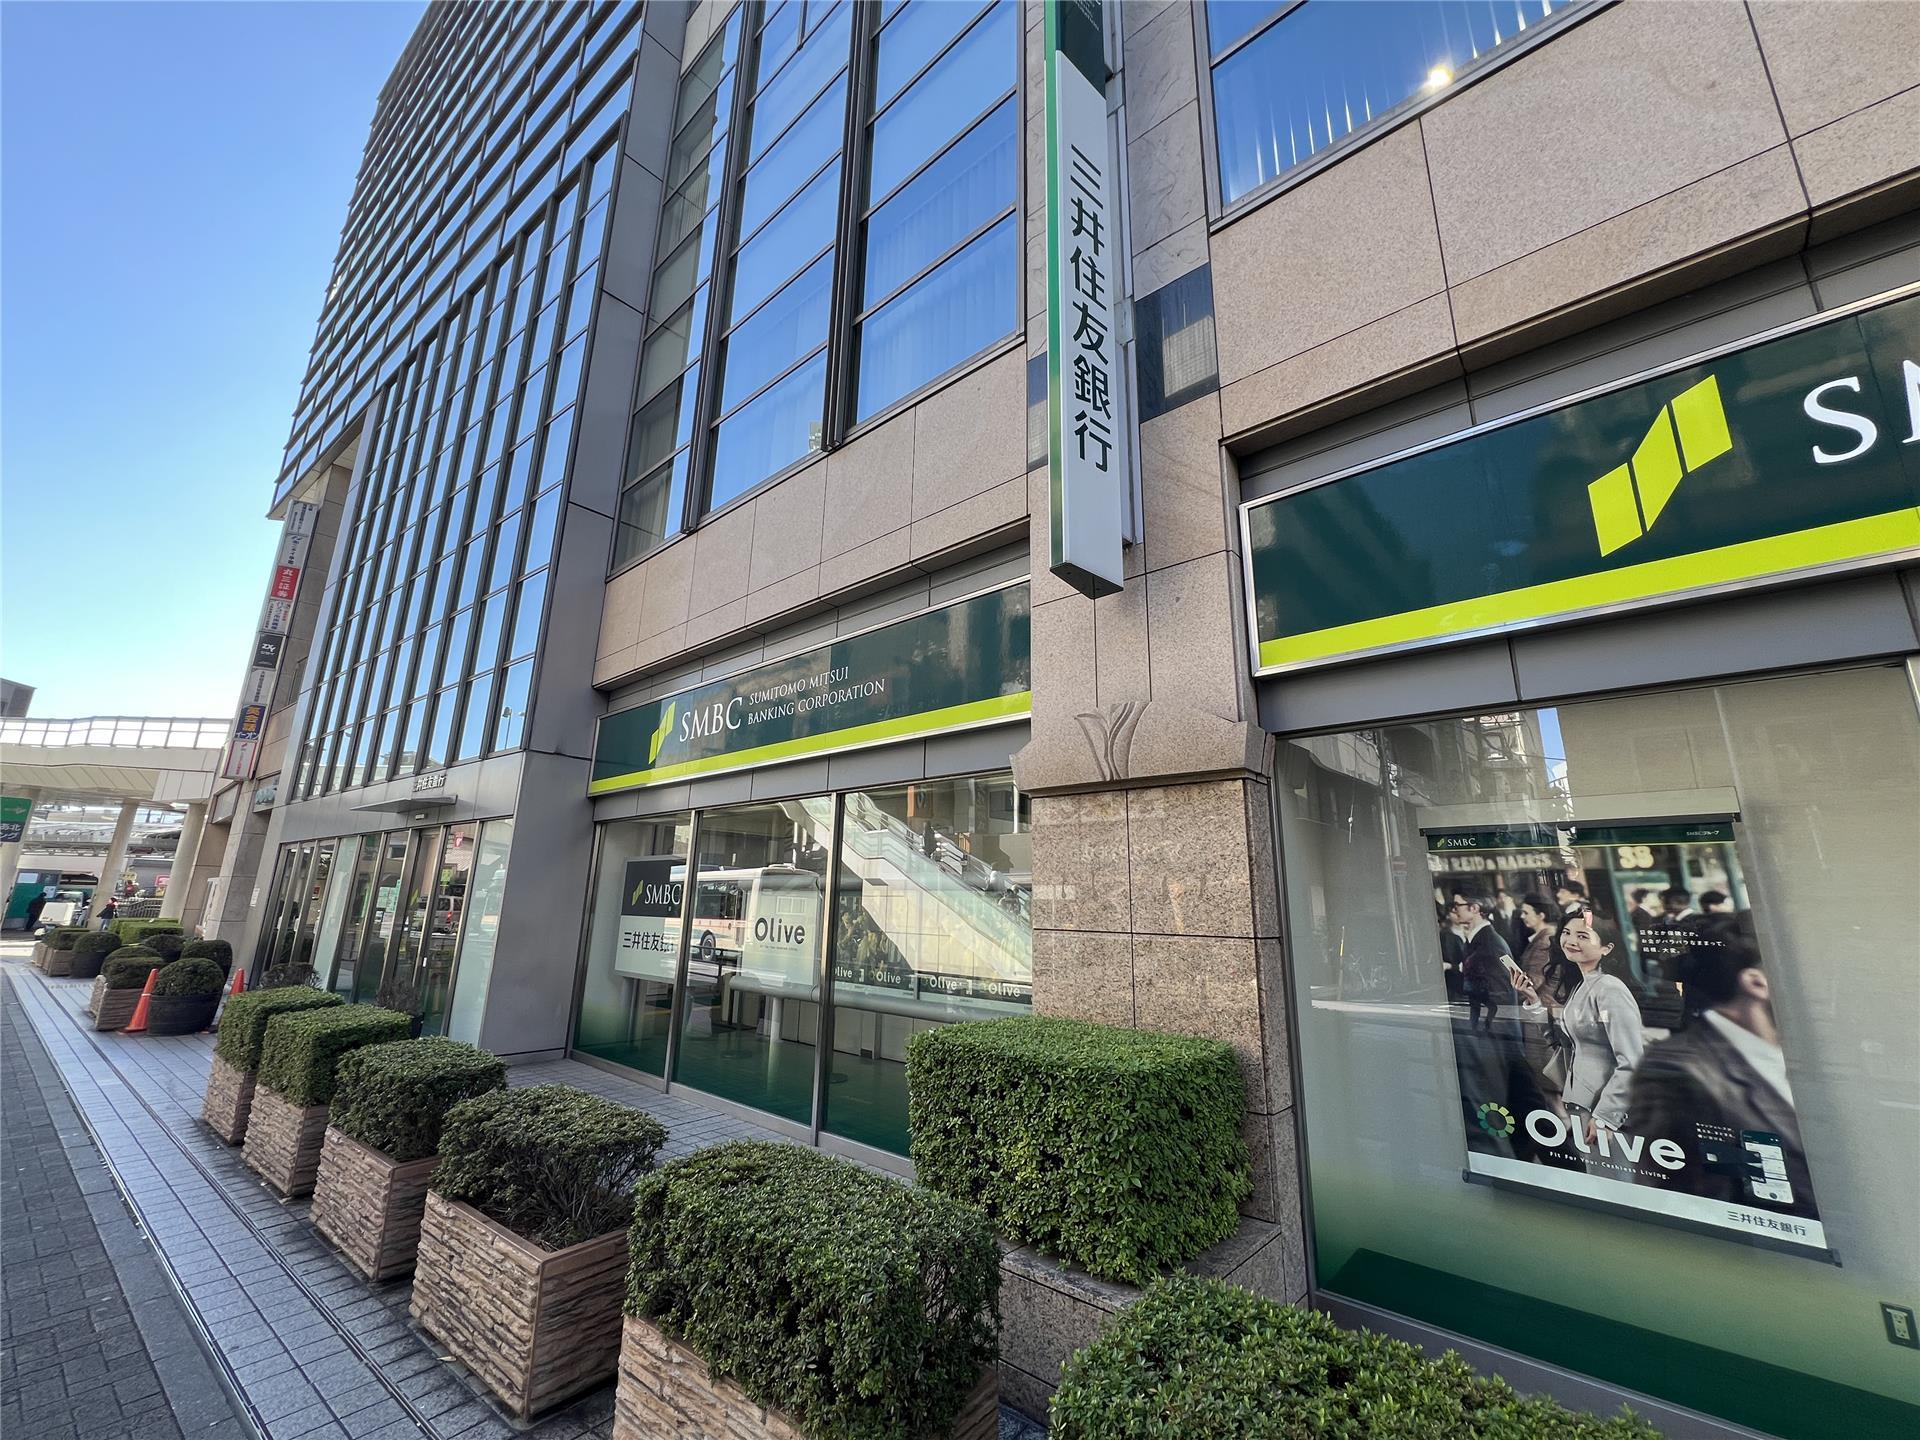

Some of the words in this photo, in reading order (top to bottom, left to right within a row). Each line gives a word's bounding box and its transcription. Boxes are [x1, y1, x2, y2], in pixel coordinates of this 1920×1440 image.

[1070, 143, 1112, 472] 三井住友銀行
[1803, 360, 1920, 464] S
[749, 679, 807, 706] SUMITOMO
[809, 666, 849, 689] MITSUI
[748, 702, 795, 725] BANKING
[798, 679, 885, 713] CORPORATION
[679, 697, 743, 742] SMBC
[1447, 838, 1477, 847] SMBC
[644, 883, 681, 905] SMBC
[755, 917, 806, 945] Olive
[876, 970, 901, 985] Olive
[929, 975, 958, 991] Olive
[988, 982, 1022, 998] Olive
[1525, 1109, 1686, 1171] Olive
[1727, 1210, 1806, 1236] 三井住友銀行
